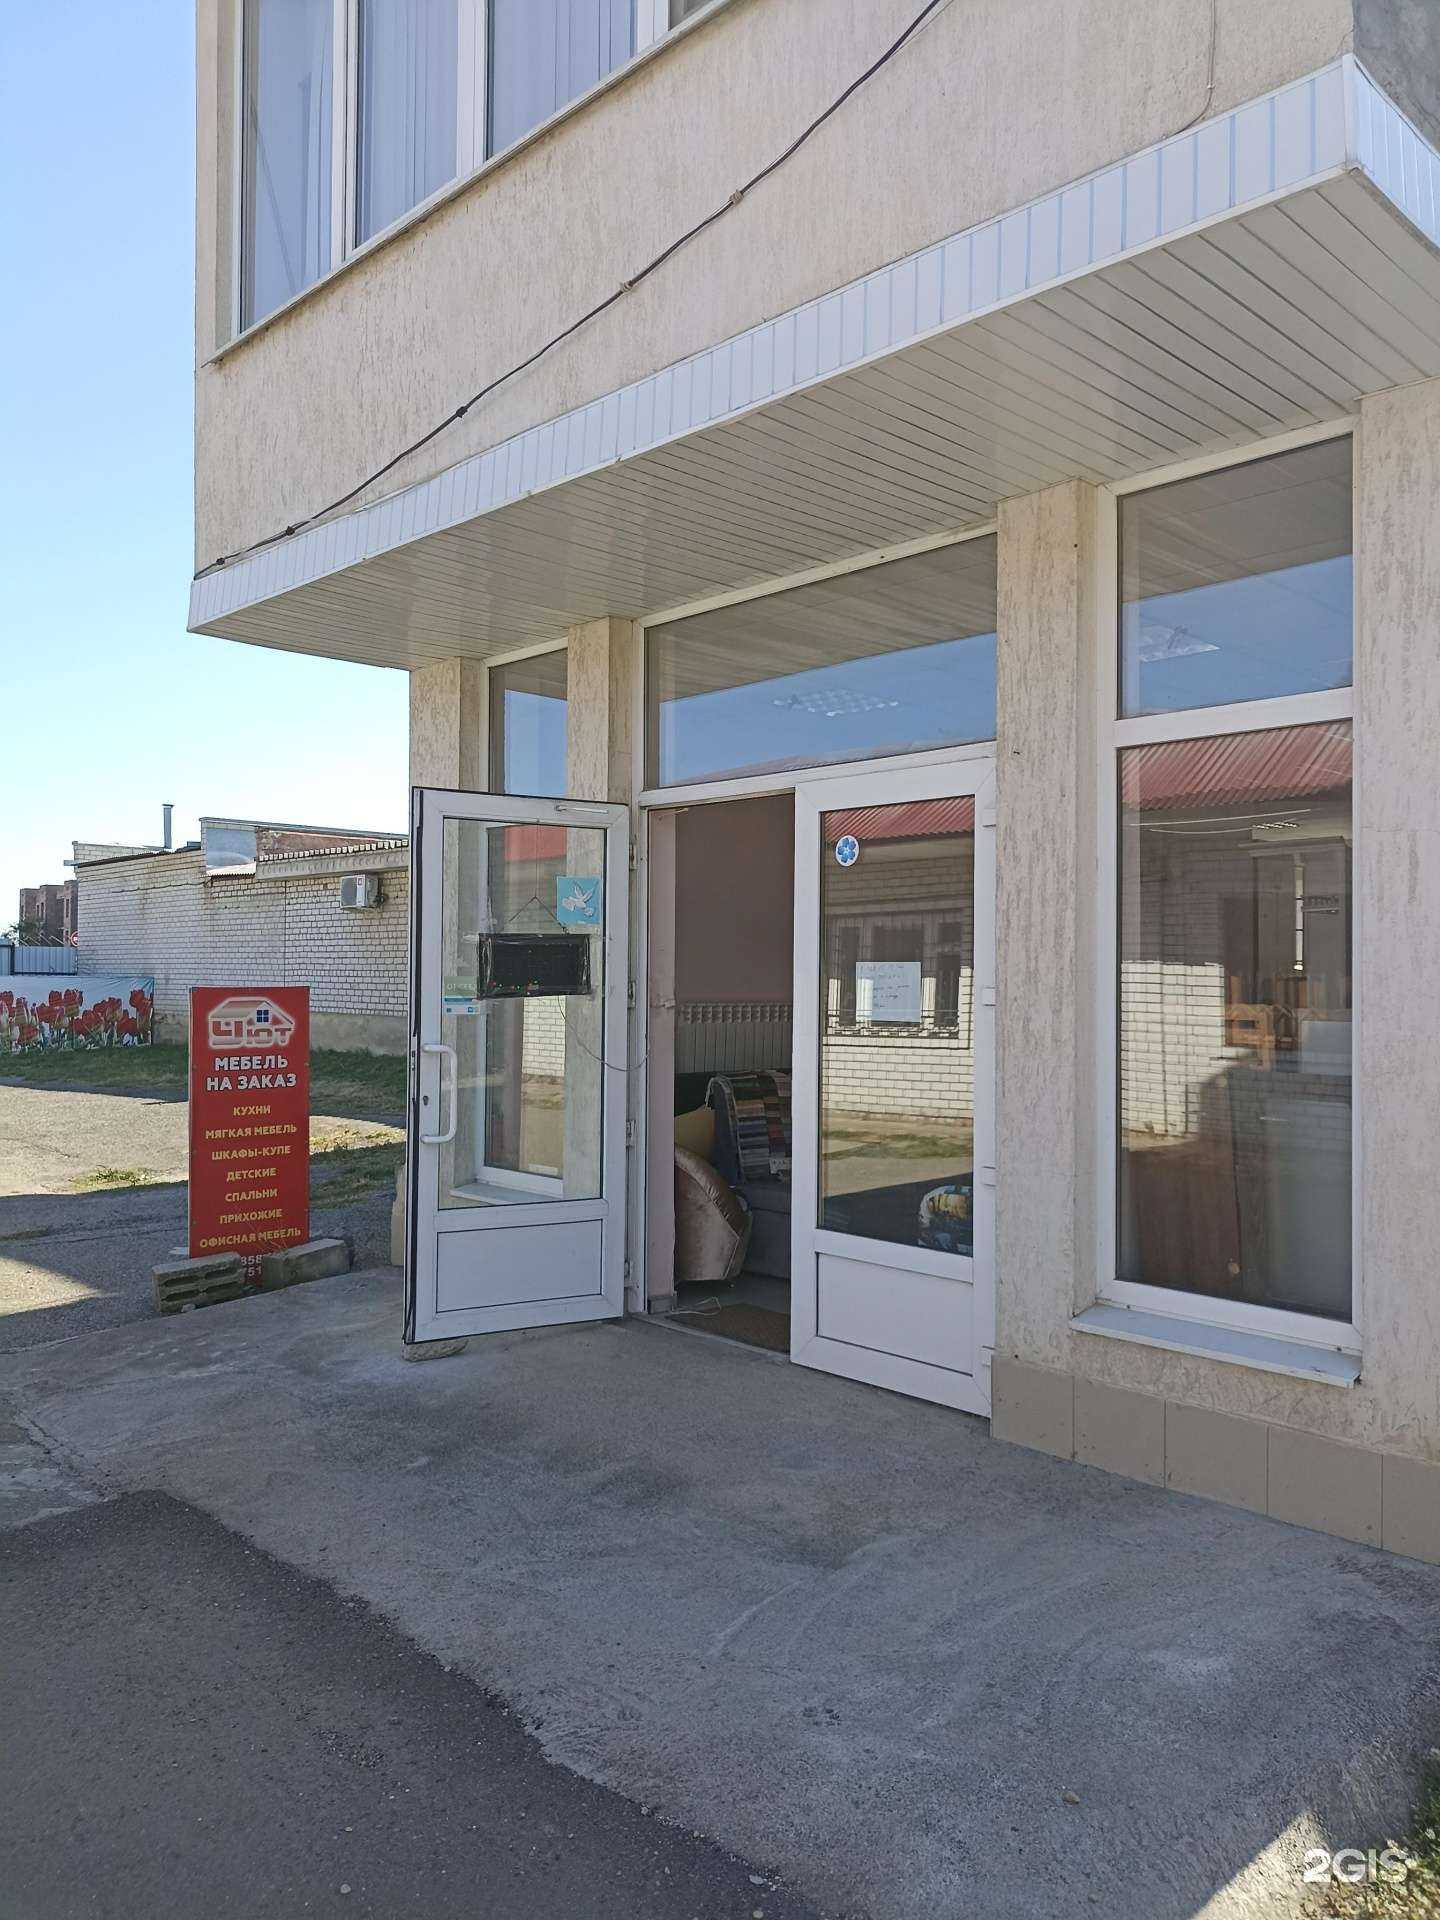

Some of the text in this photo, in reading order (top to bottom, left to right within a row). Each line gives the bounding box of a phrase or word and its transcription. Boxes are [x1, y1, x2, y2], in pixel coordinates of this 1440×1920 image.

[214, 1055, 288, 1071] МЕБЕЛЬ
[207, 1073, 297, 1091] НА ЗАКАЗ
[233, 1104, 271, 1116] КУХНИ
[205, 1123, 298, 1139] МЯГКАЯ МЕБЕЛЬ
[211, 1145, 291, 1160] ШКАФЫ-КУПЕ
[226, 1167, 277, 1182] ДЕТСКИЕ
[225, 1188, 278, 1202] СПАЛЬНИ
[219, 1208, 282, 1224] ПРИХОЖИЕ
[199, 1227, 301, 1248] ОФИСНАЯ МЕБЕЛЬ
